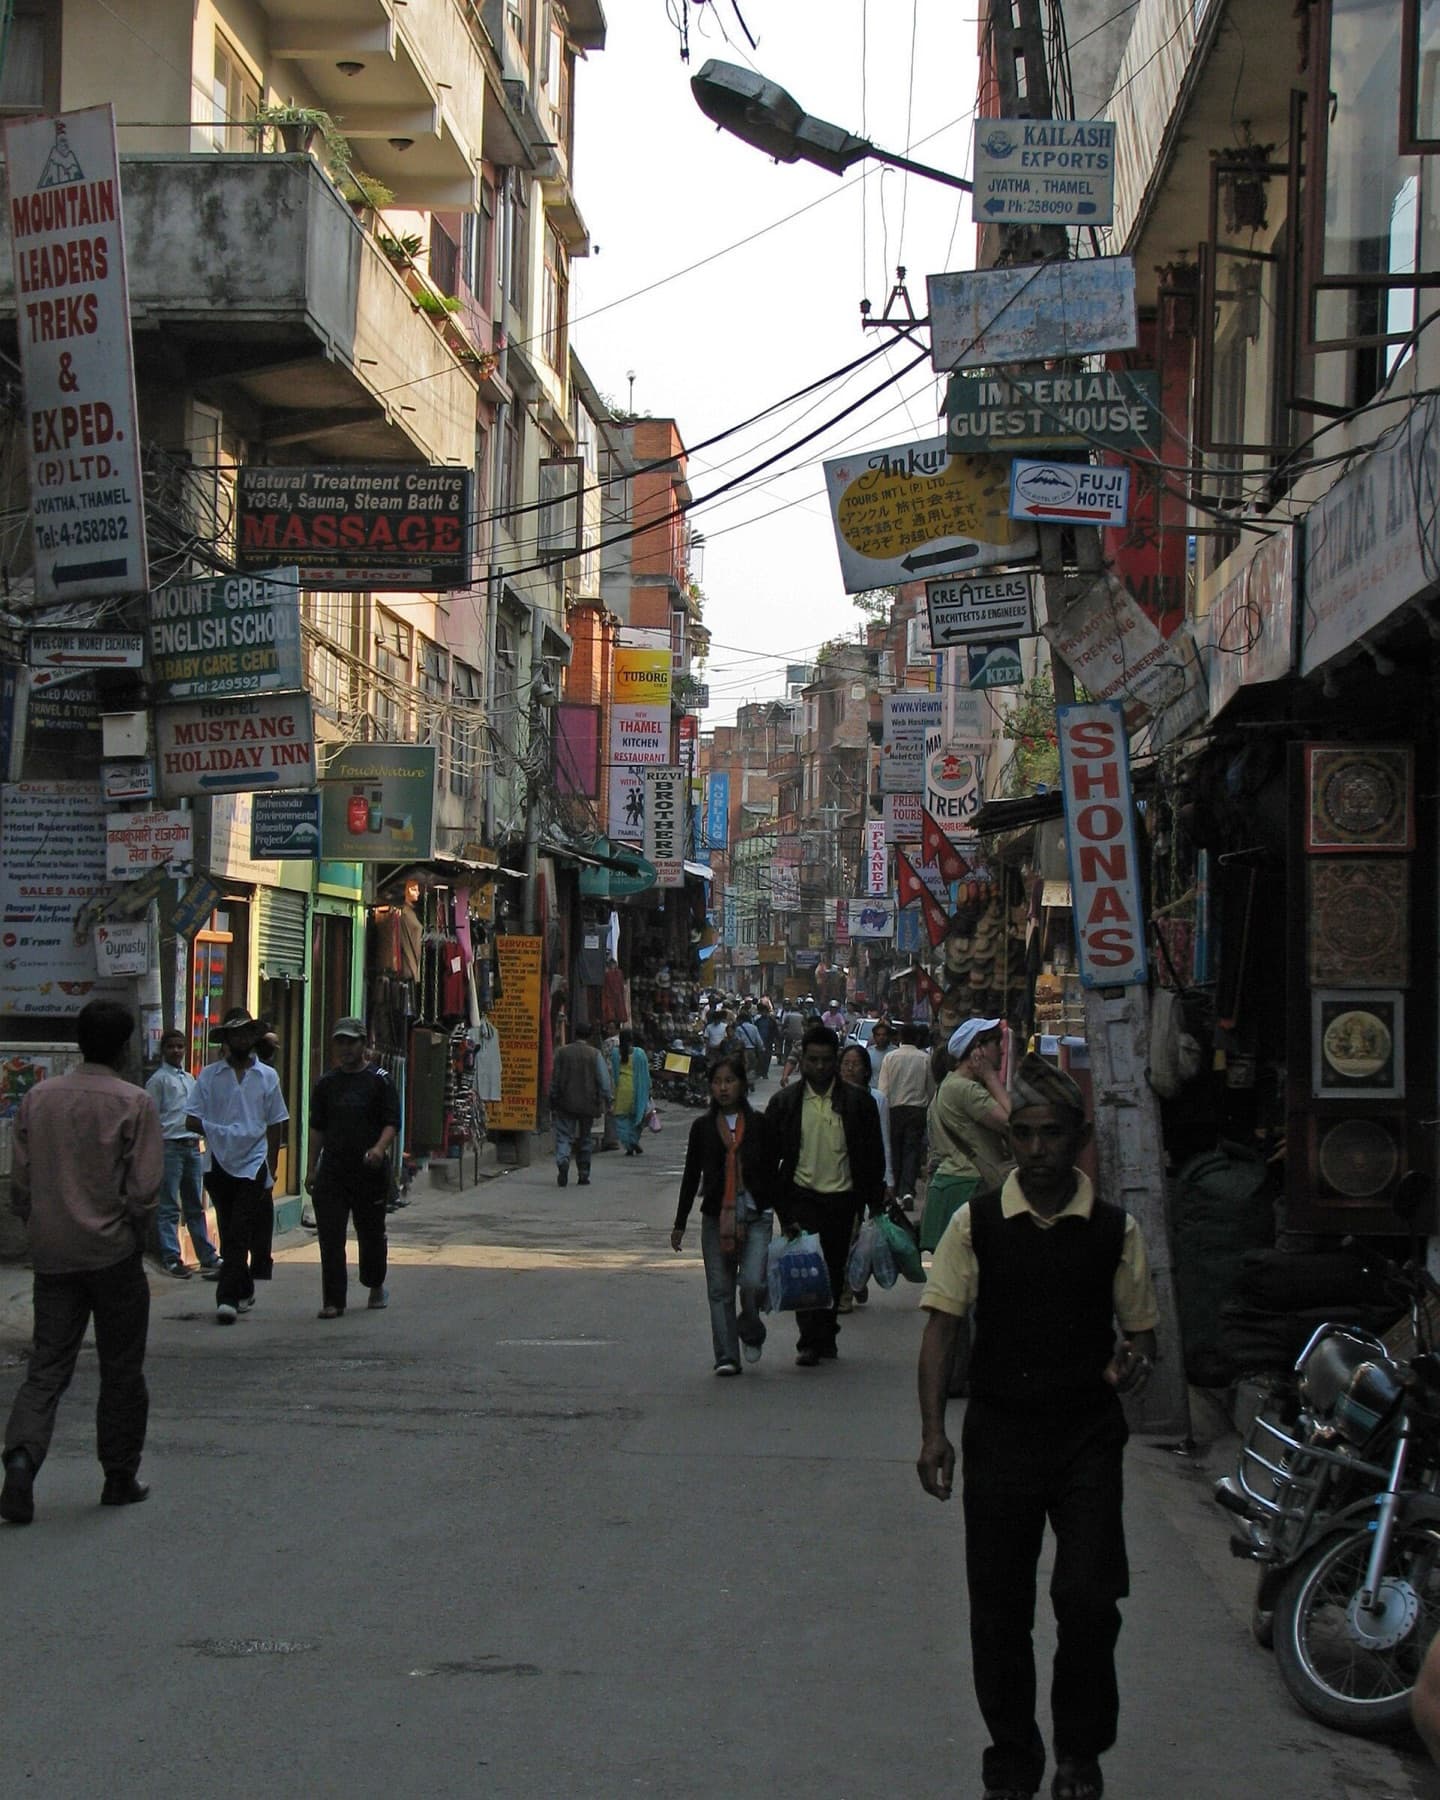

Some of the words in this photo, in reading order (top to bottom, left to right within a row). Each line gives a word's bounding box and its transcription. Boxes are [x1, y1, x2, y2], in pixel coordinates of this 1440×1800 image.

[1023, 125, 1112, 148] KAILASH
[1021, 151, 1109, 170] EXPORTS
[1043, 180, 1094, 195] THAMEL
[13, 179, 115, 238] MOUNTAIN
[19, 236, 109, 294] LEADERS
[27, 293, 99, 344] TREKS
[59, 352, 80, 393] &
[977, 377, 1126, 406] IMPERIAL
[32, 402, 124, 453] EXPED.
[950, 408, 1045, 437] GUEST
[1059, 405, 1148, 433] HOUSE
[243, 472, 306, 491] Natural
[313, 473, 400, 490] Treatment
[405, 474, 463, 491] Centre
[1079, 472, 1122, 492] FUJI
[82, 487, 132, 508] THAMEL
[246, 492, 293, 513] YOGA,
[298, 493, 349, 513] Sauna,
[354, 492, 403, 511] Steam
[408, 493, 444, 511] Bath
[449, 494, 460, 511] &
[845, 493, 878, 508] TOURS
[1077, 491, 1122, 510] HOTEL
[242, 513, 462, 552] MASSAGE
[346, 569, 412, 580] Floor
[150, 582, 217, 620] MOUNT
[932, 581, 1026, 606] CREATEERS
[935, 610, 981, 626] ARCHITECTS
[987, 606, 1027, 622] ENGINEERS
[151, 616, 227, 656] ENGLISH
[231, 608, 297, 647] SCHOOL
[33, 636, 75, 650] WELCOME
[78, 636, 103, 651] MONEY
[105, 636, 141, 651] EXCHANGE
[1074, 617, 1137, 668] TREKKING
[165, 656, 200, 680] BABY
[202, 652, 239, 676] CARE
[623, 671, 668, 683] TUBORG
[30, 702, 62, 716] TRAVEL
[174, 716, 295, 745] MUSTANG
[619, 720, 662, 734] THAMEL
[622, 737, 659, 748] KITCHEN
[164, 745, 264, 775] HOLIDAY
[271, 742, 311, 766] INN
[614, 752, 666, 763] RESTAURANT
[129, 776, 152, 788] HOTEL
[646, 772, 682, 780] RIZVI
[19, 784, 48, 793] Our
[927, 787, 978, 817] TREKS
[256, 810, 317, 821] Environmental
[654, 781, 674, 859] BROTHERS
[893, 809, 922, 820] TOURS
[10, 823, 34, 832] Hotel
[38, 823, 95, 832] Reservation
[255, 822, 293, 832] Education
[255, 834, 284, 846] Project
[871, 831, 884, 891] PLANET
[19, 886, 63, 896] SALES
[68, 886, 113, 896] AGENT
[5, 903, 36, 913] Royal
[39, 904, 71, 914] Nepal
[105, 941, 147, 959] Dynasty
[499, 940, 540, 948] SERVICES
